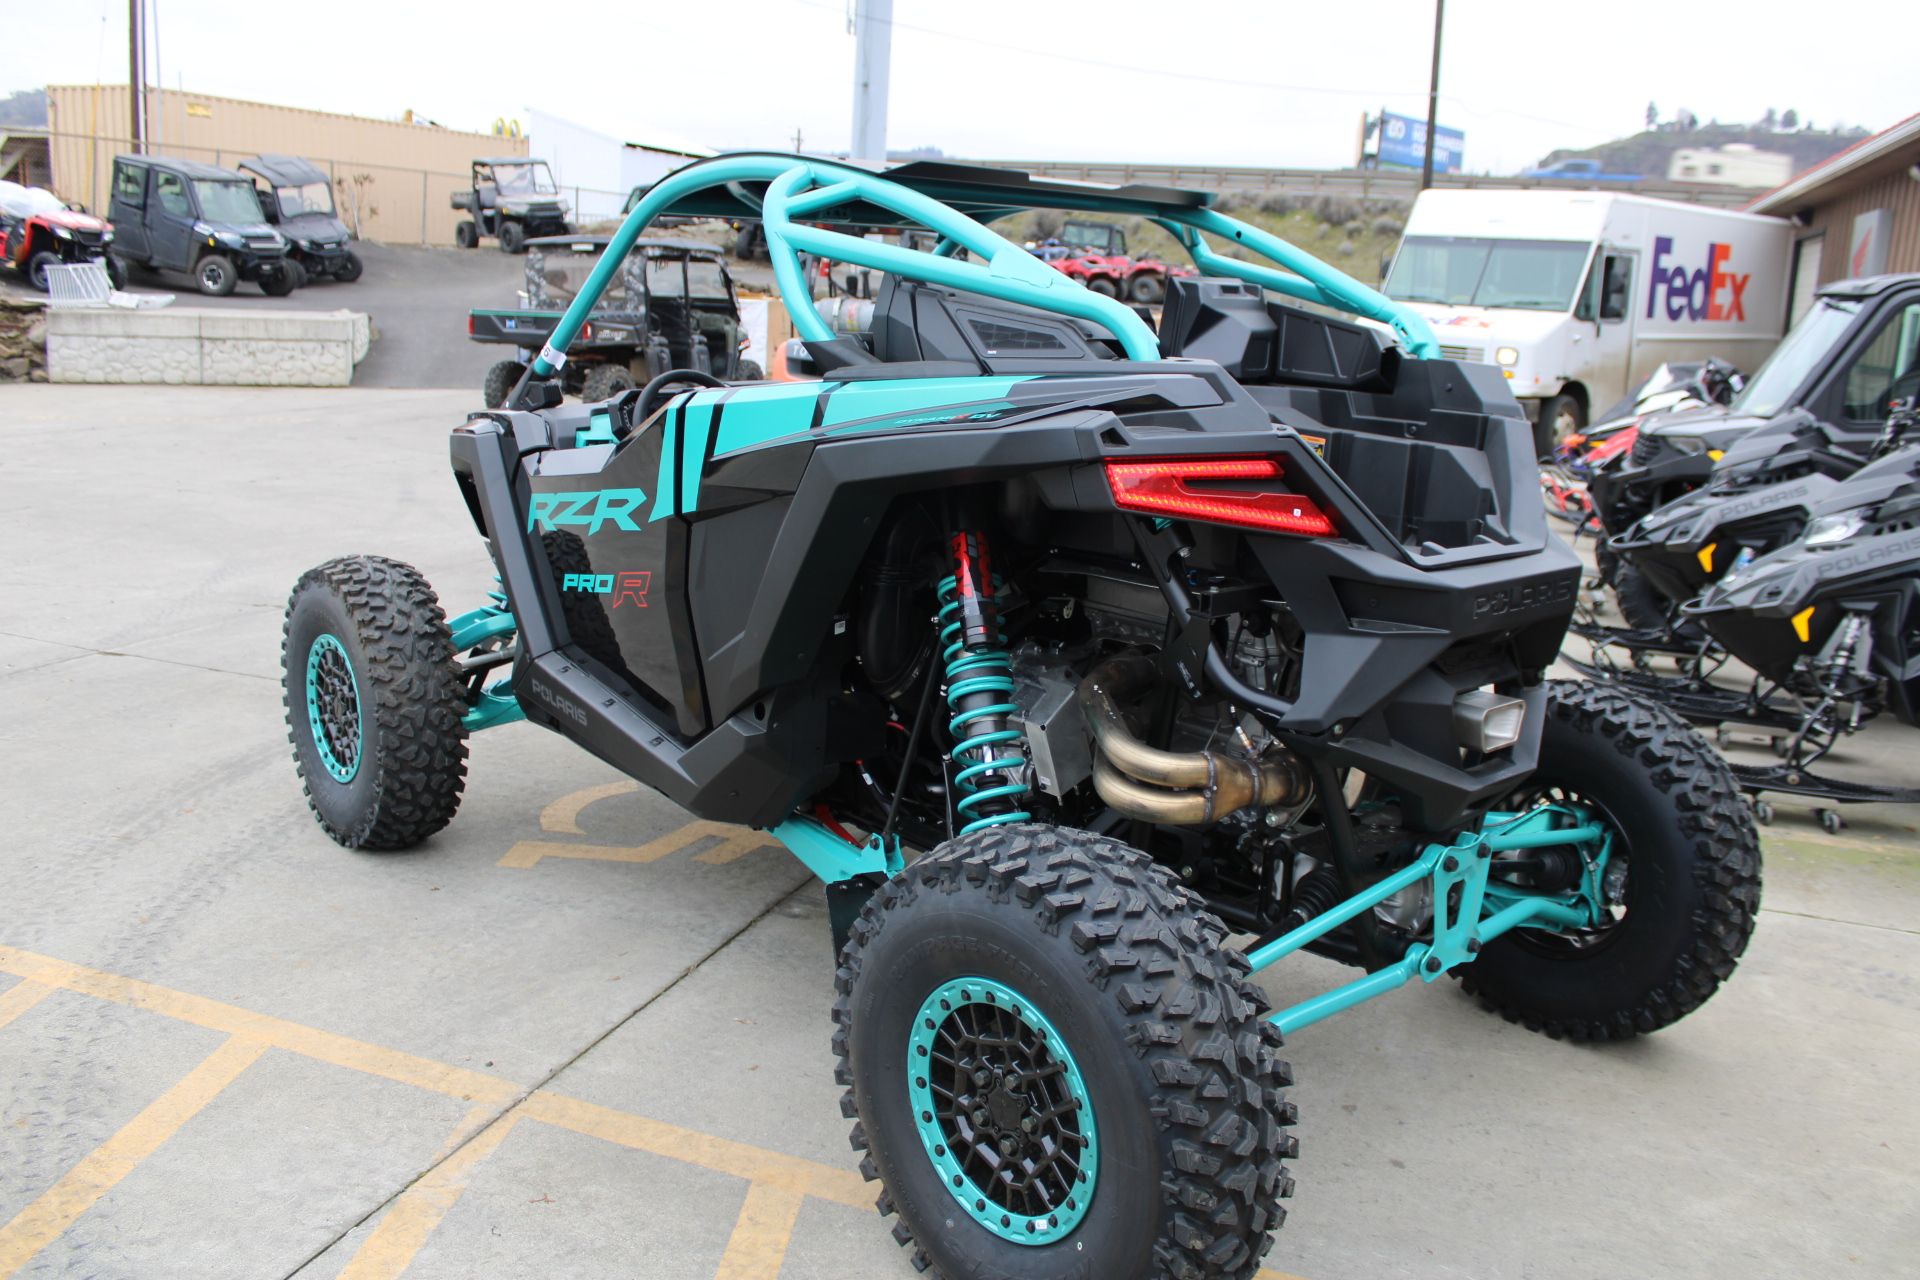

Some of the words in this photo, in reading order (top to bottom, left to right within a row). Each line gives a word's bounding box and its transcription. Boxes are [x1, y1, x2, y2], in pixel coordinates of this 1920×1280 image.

[1647, 236, 1751, 321] FedEx
[527, 487, 648, 537] RZR
[1719, 485, 1809, 519] POLARIS
[562, 573, 615, 593] PRO
[612, 571, 652, 609] R
[1472, 580, 1572, 620] POLARIS
[531, 678, 588, 726] POLARIS
